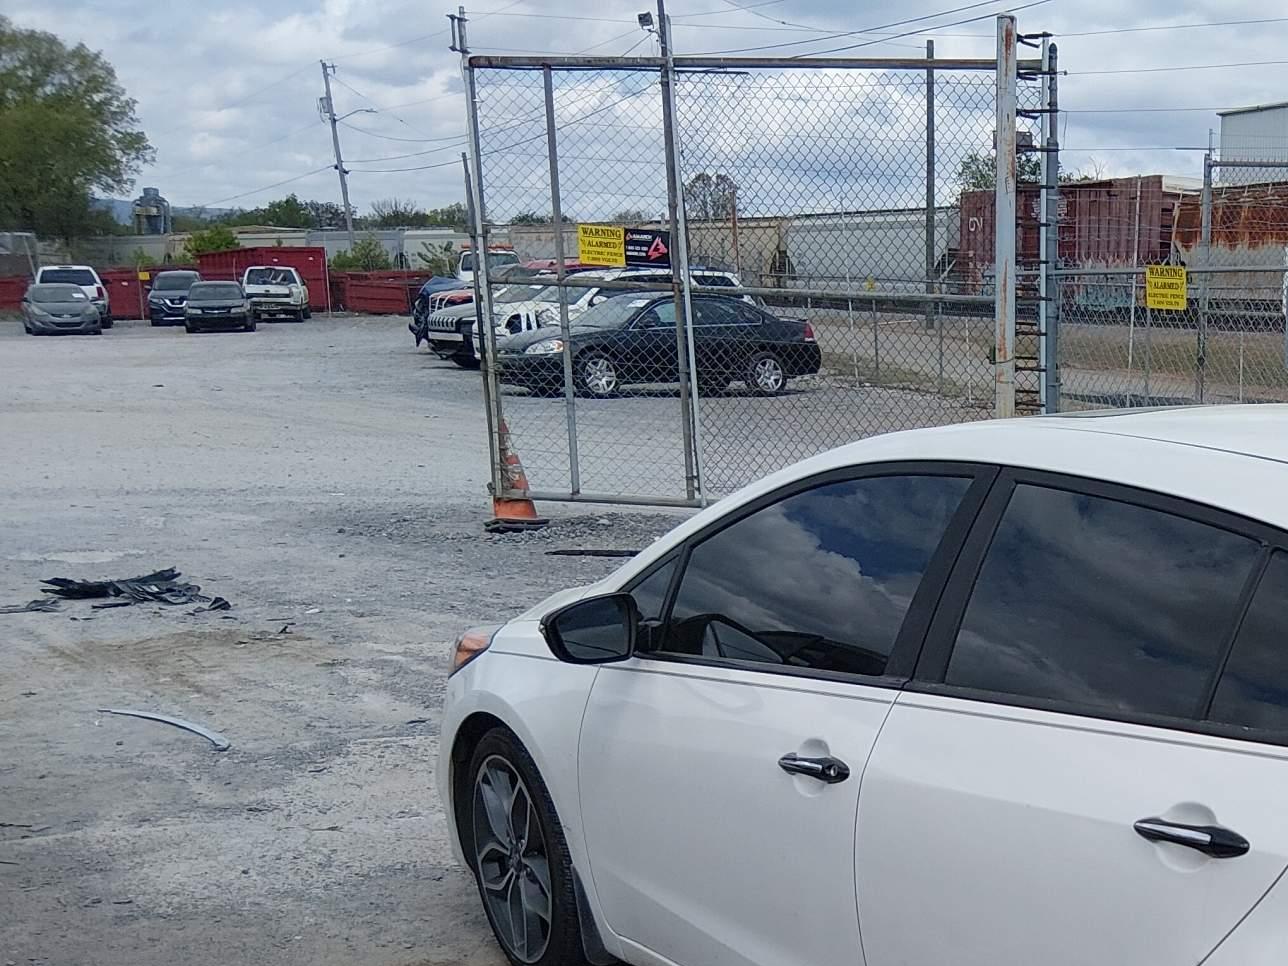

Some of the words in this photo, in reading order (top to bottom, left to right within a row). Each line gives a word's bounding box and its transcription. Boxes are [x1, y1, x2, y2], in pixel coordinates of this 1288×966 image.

[581, 227, 622, 238] WARNING
[587, 240, 617, 249] ALARMED
[1149, 267, 1183, 278] WARNING
